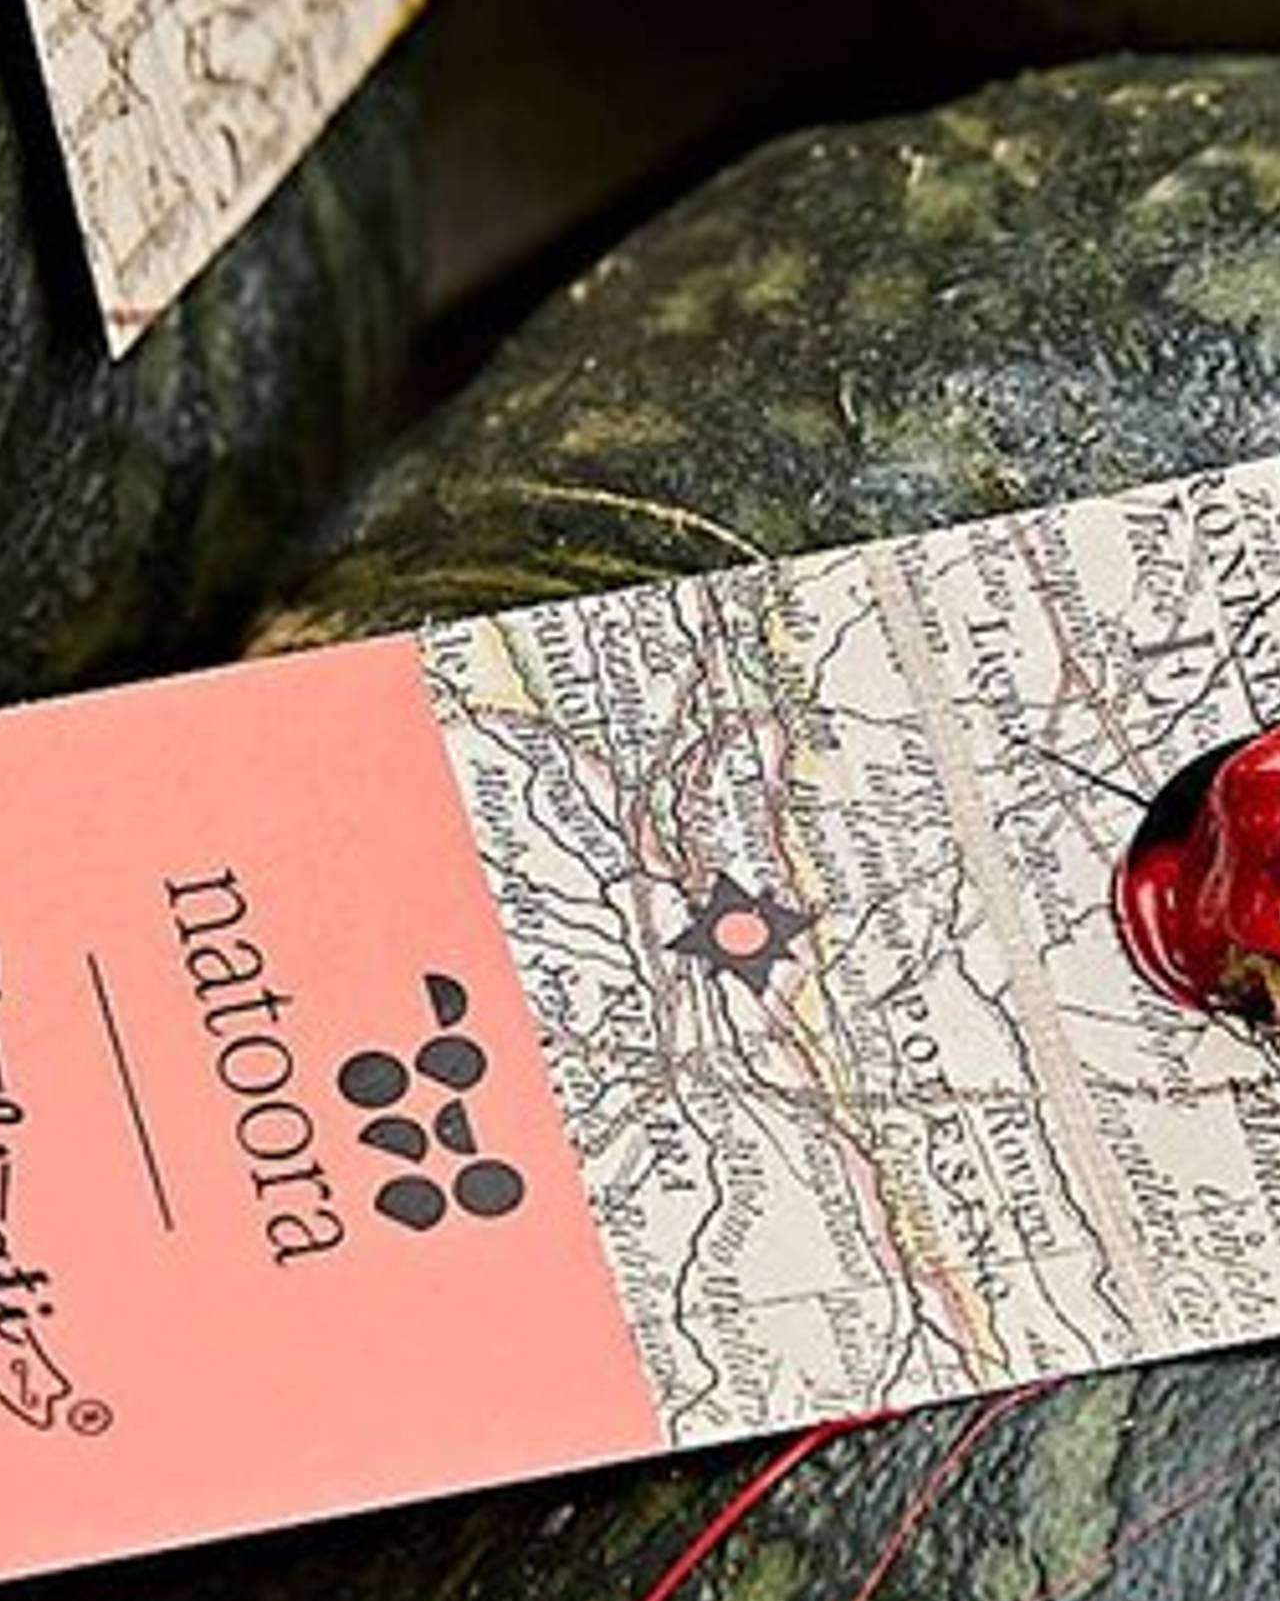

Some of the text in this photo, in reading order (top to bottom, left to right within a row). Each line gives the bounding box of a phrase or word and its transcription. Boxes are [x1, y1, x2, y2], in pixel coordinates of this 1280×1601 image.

[166, 870, 343, 1263] natoora
[596, 976, 700, 1196] FERRARA
[978, 1097, 1067, 1252] Rovigo
